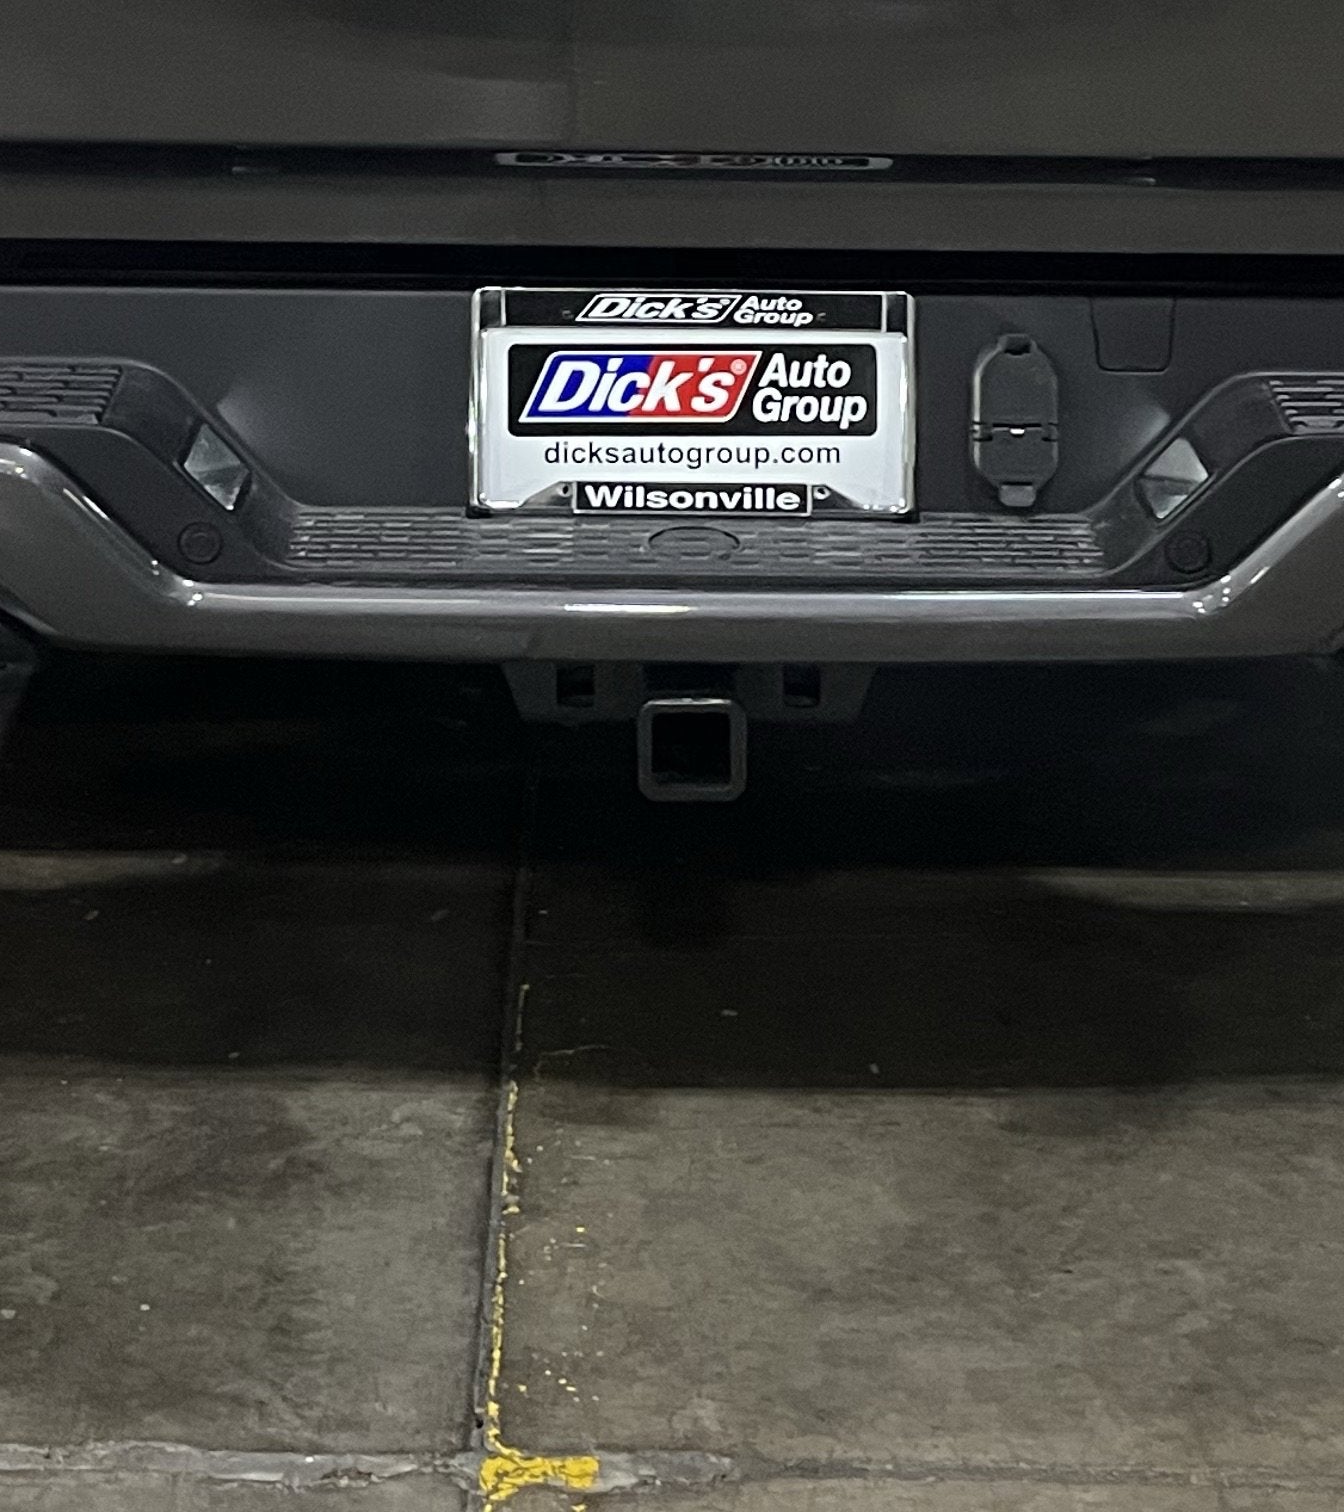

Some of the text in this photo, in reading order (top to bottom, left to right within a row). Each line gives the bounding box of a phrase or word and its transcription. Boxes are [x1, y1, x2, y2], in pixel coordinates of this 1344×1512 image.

[740, 295, 803, 311] Auto
[733, 310, 814, 327] Group
[758, 353, 851, 388] Auto
[538, 357, 737, 413] Dick's
[753, 391, 868, 429] Group
[544, 441, 841, 469] dicksautogroup.com
[585, 485, 801, 512] Wilsonville
